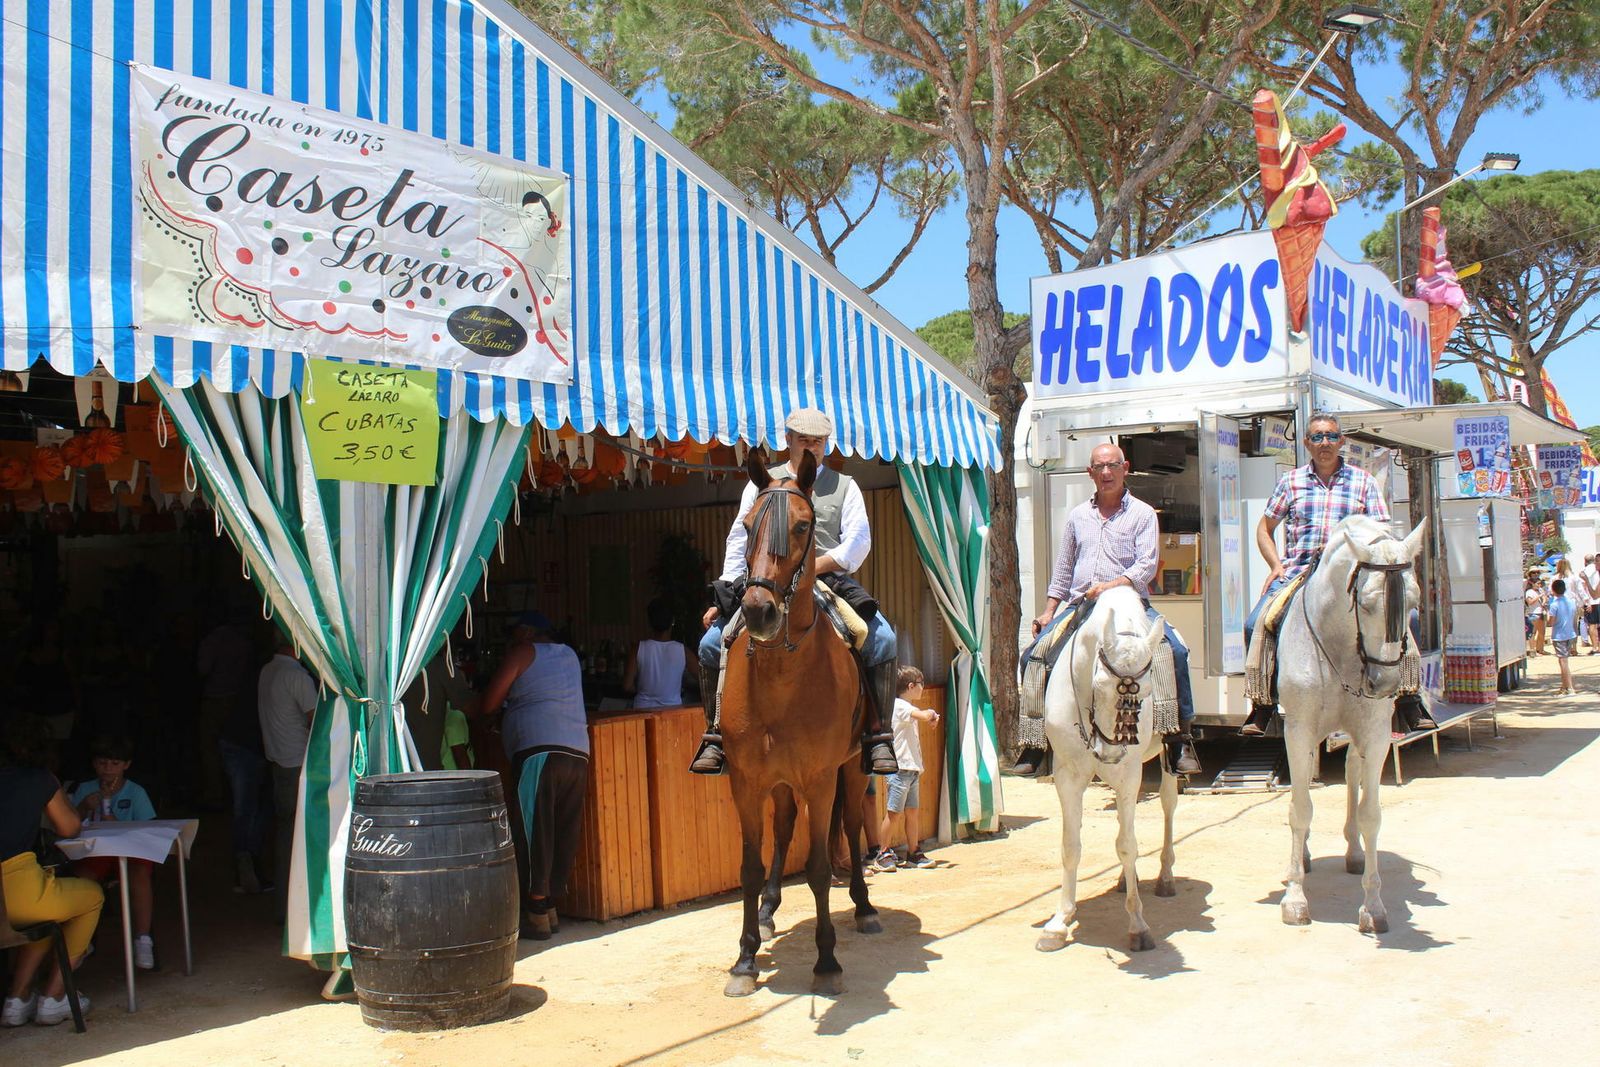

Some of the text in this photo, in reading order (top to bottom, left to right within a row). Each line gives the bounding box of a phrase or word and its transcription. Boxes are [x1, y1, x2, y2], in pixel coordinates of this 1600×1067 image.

[154, 84, 385, 153] fundada en 1975
[161, 115, 465, 238] Caseta
[320, 225, 504, 298] Lazaro
[463, 310, 513, 328] Manzanilla
[1039, 258, 1279, 386] HELADOS
[1311, 258, 1431, 407] HELADERIA
[337, 370, 408, 388] CASETA
[318, 411, 418, 434] CUBATAS
[1456, 421, 1505, 435] BEBIDAS
[1464, 434, 1497, 447] FRIAS
[1539, 449, 1578, 461] BEBIDAS
[1545, 459, 1571, 470] FRIAS
